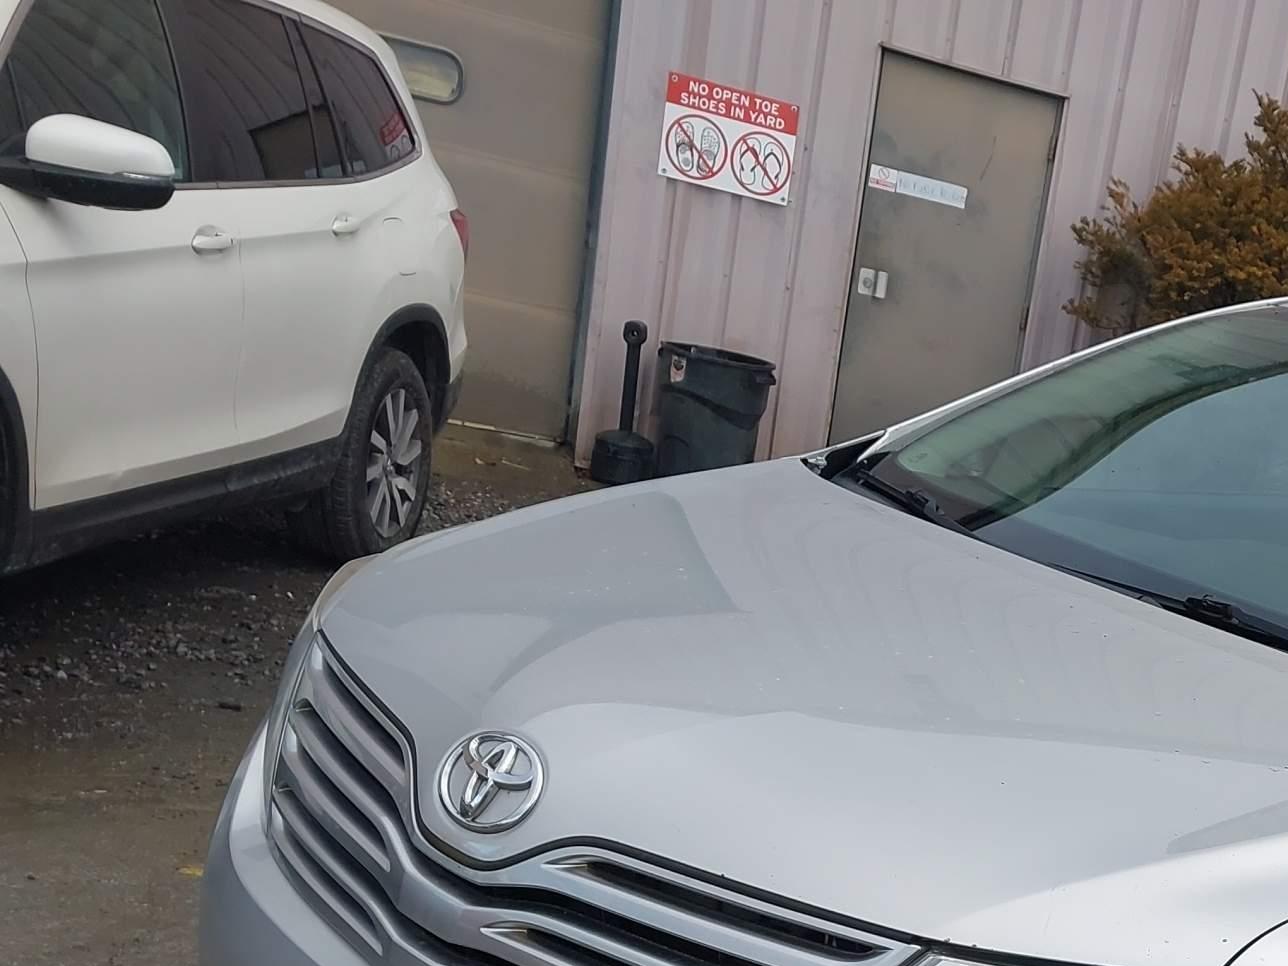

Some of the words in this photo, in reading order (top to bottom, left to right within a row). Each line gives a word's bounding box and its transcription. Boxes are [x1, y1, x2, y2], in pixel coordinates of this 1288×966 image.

[680, 92, 726, 114] SHOES
[730, 105, 744, 119] IN
[749, 110, 785, 129] YARD
[688, 81, 709, 95] NO
[712, 87, 750, 107] OPEN
[754, 98, 780, 115] TOE
